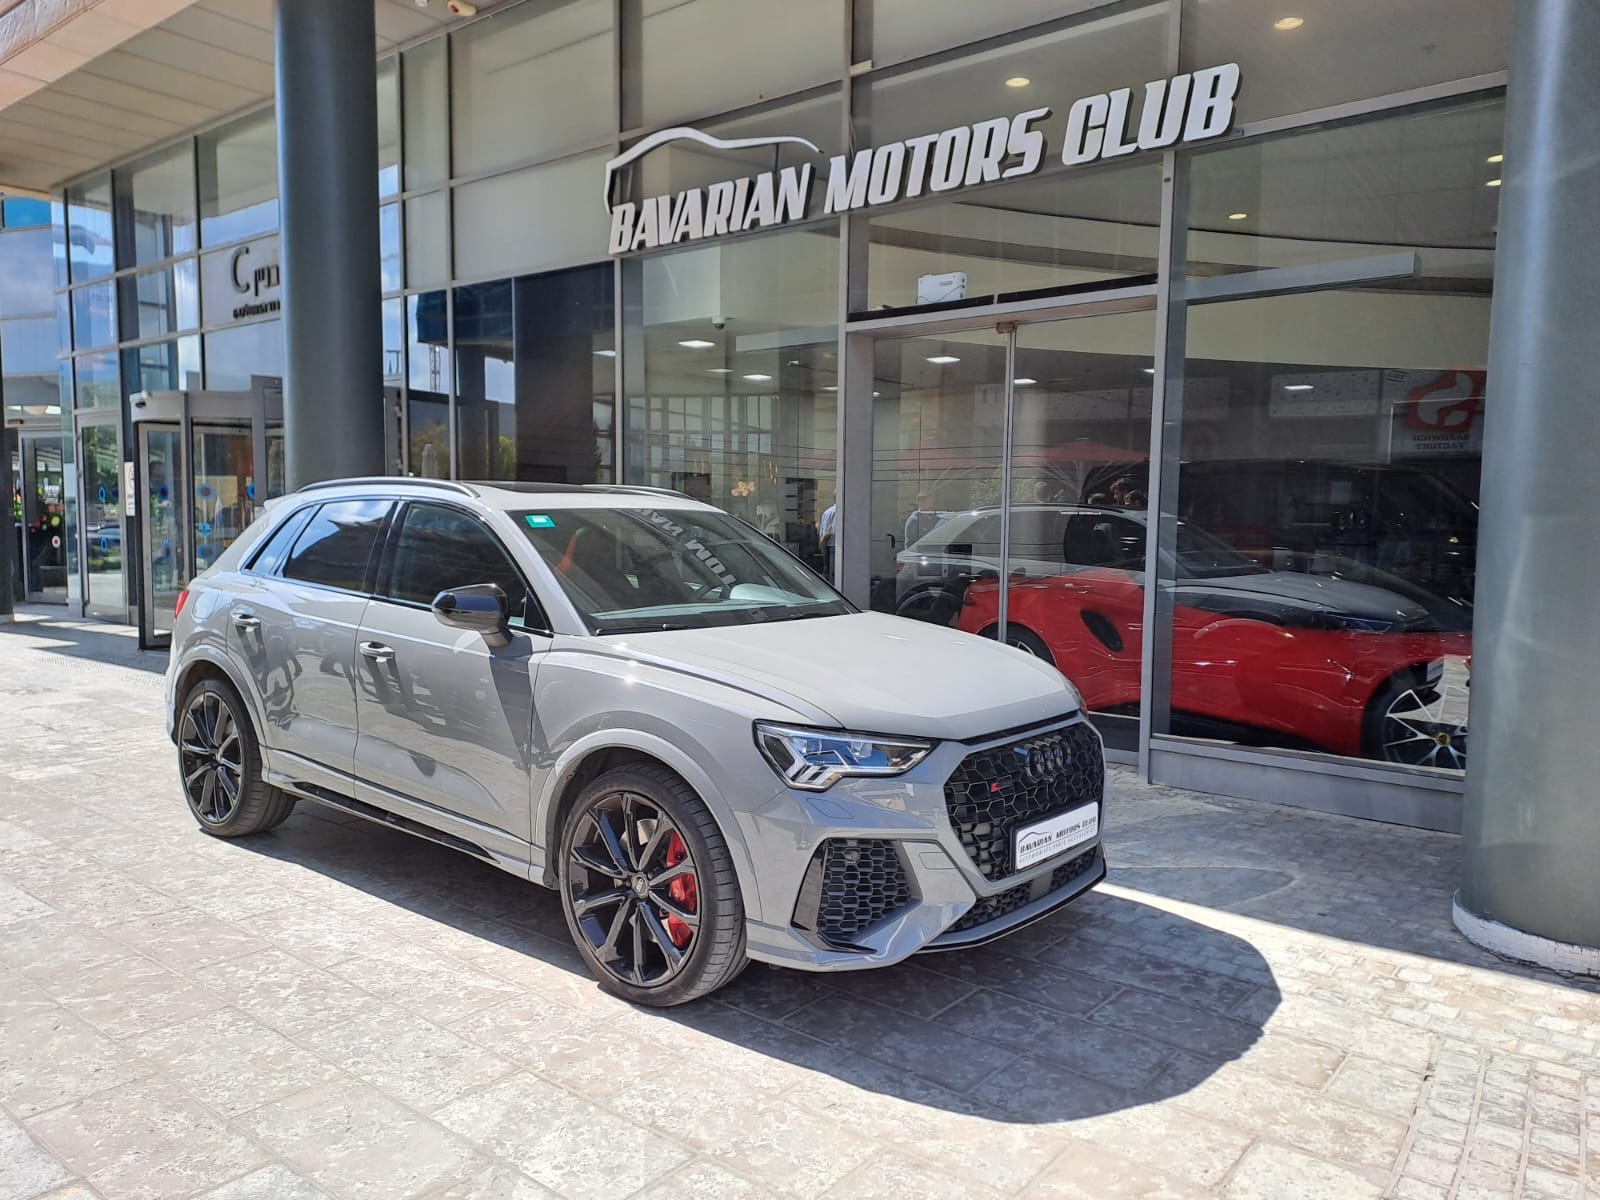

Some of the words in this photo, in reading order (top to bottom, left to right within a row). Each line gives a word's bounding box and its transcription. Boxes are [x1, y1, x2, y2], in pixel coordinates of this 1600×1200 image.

[608, 162, 814, 255] BAVARIAN
[823, 106, 1053, 215] MOTORS
[1061, 62, 1243, 167] CLUB
